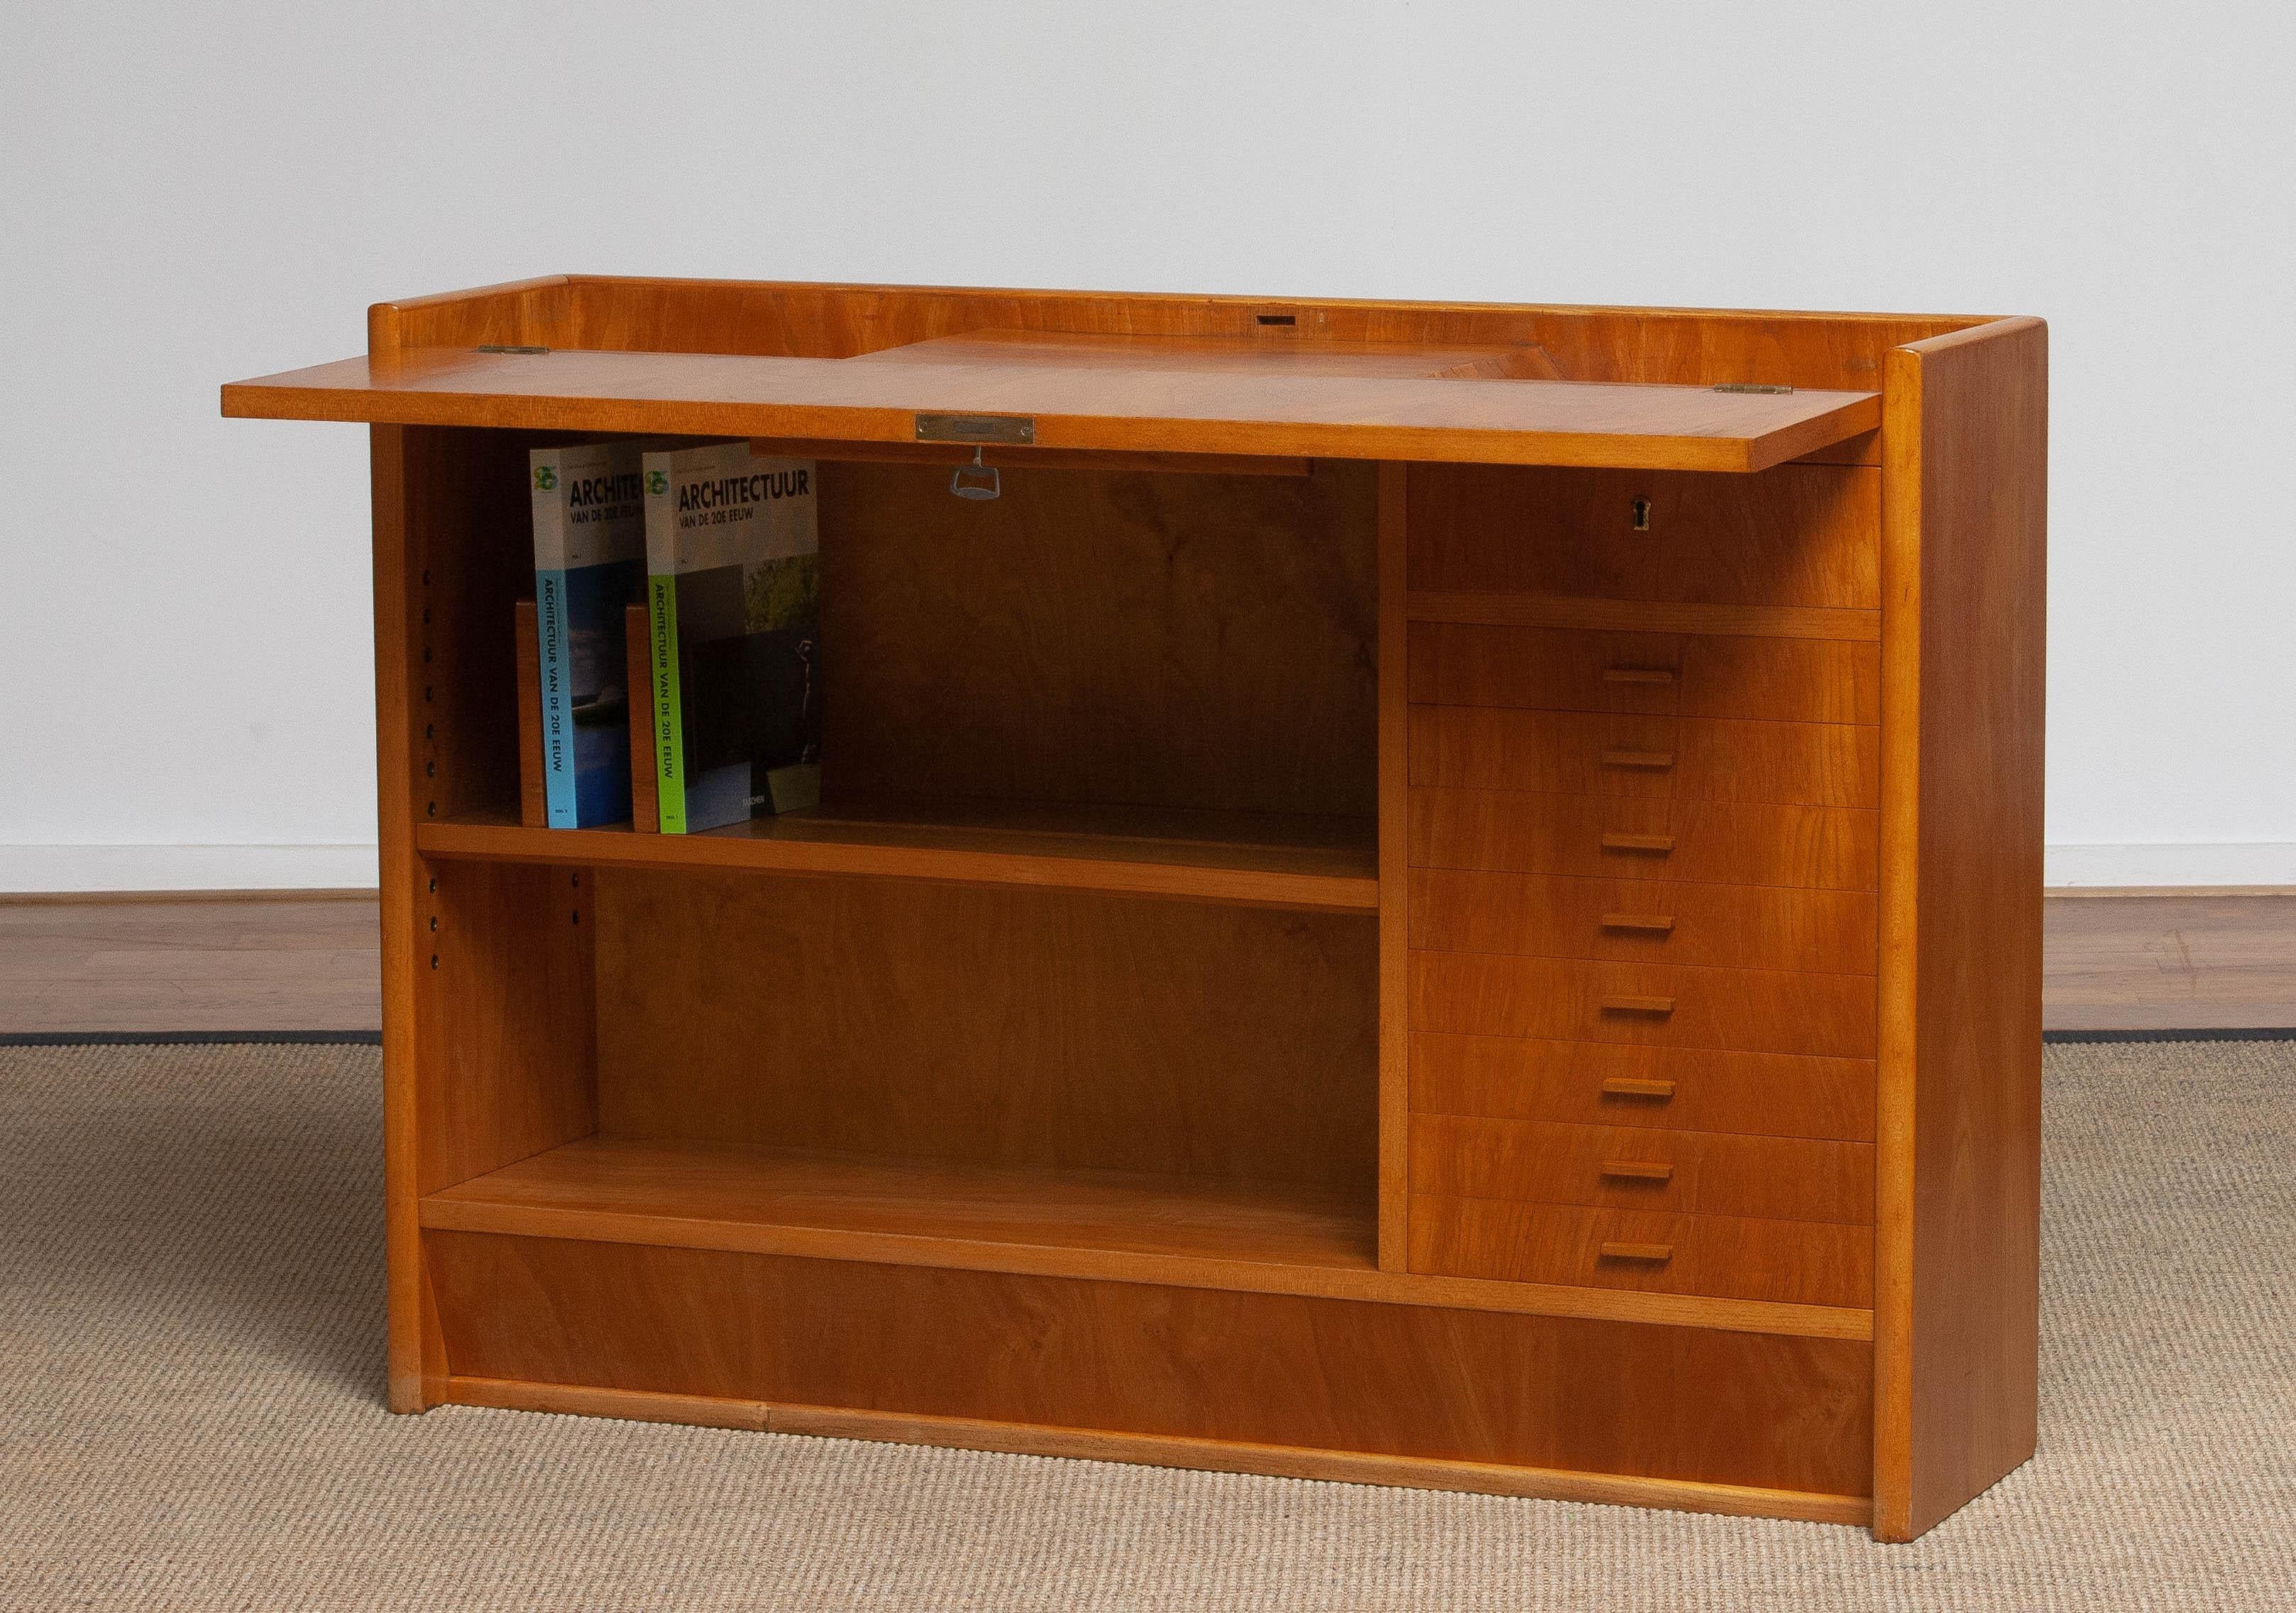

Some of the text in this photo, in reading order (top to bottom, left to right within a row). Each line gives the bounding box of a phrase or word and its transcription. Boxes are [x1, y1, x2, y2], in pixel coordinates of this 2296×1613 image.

[679, 470, 810, 512] ARCHITECTUUR
[570, 510, 589, 525] VAN
[592, 509, 602, 522] DE
[679, 507, 753, 530] VAN DE 20E EEUW
[544, 579, 562, 772] ARCHITECTUUR VAN DE 20E EEUW
[655, 584, 673, 778] ARCHITECTUUR VAN DE 20E EEUW
